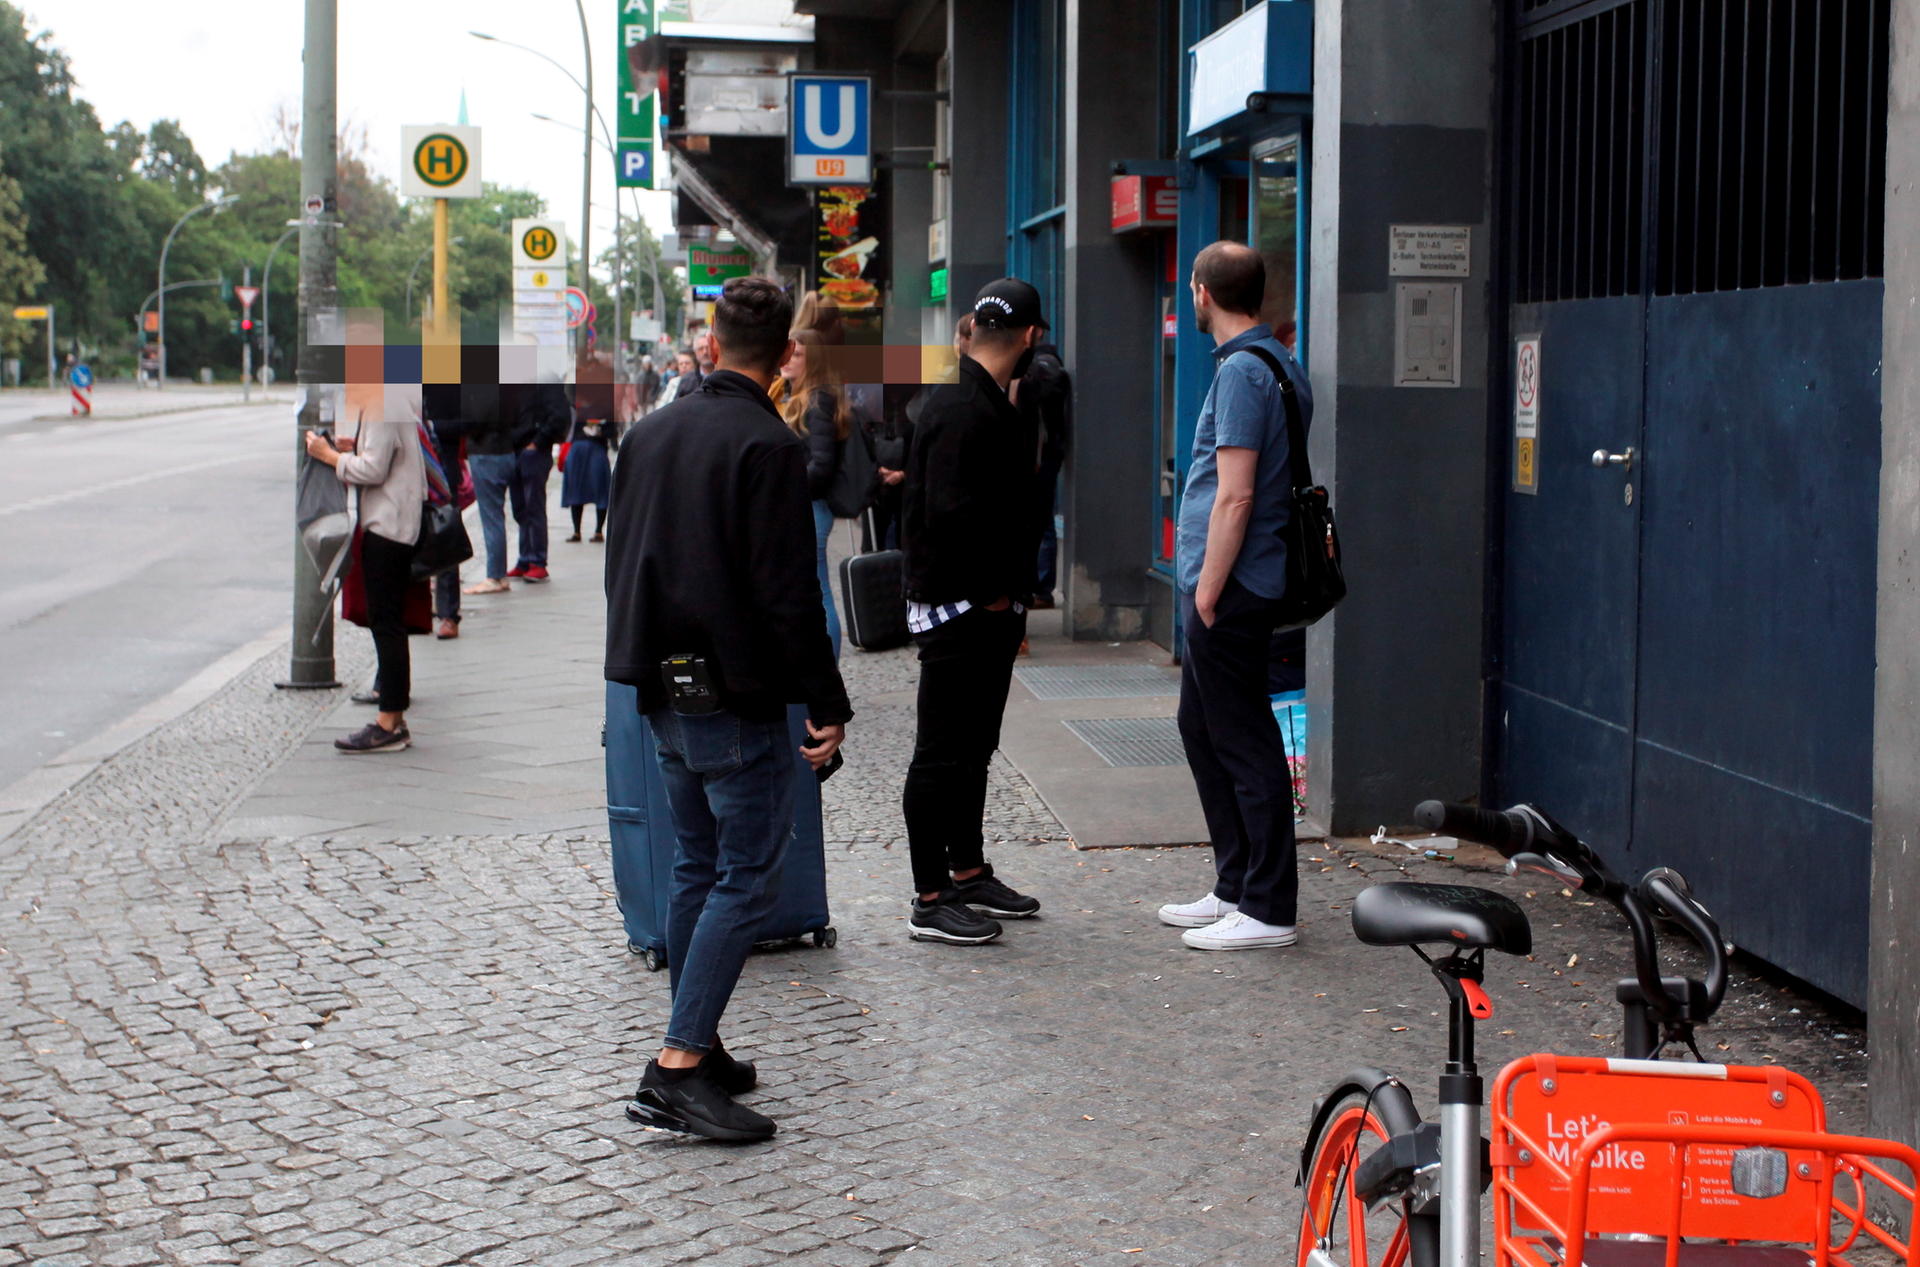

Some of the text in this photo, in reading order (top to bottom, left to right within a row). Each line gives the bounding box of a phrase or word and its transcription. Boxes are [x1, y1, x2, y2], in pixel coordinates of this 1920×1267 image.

[805, 85, 855, 149] U
[428, 146, 453, 174] H
[625, 152, 645, 177] P
[819, 160, 843, 174] U9
[531, 234, 548, 252] H
[1724, 1116, 1748, 1124] Mobike
[1749, 1117, 1763, 1126] App
